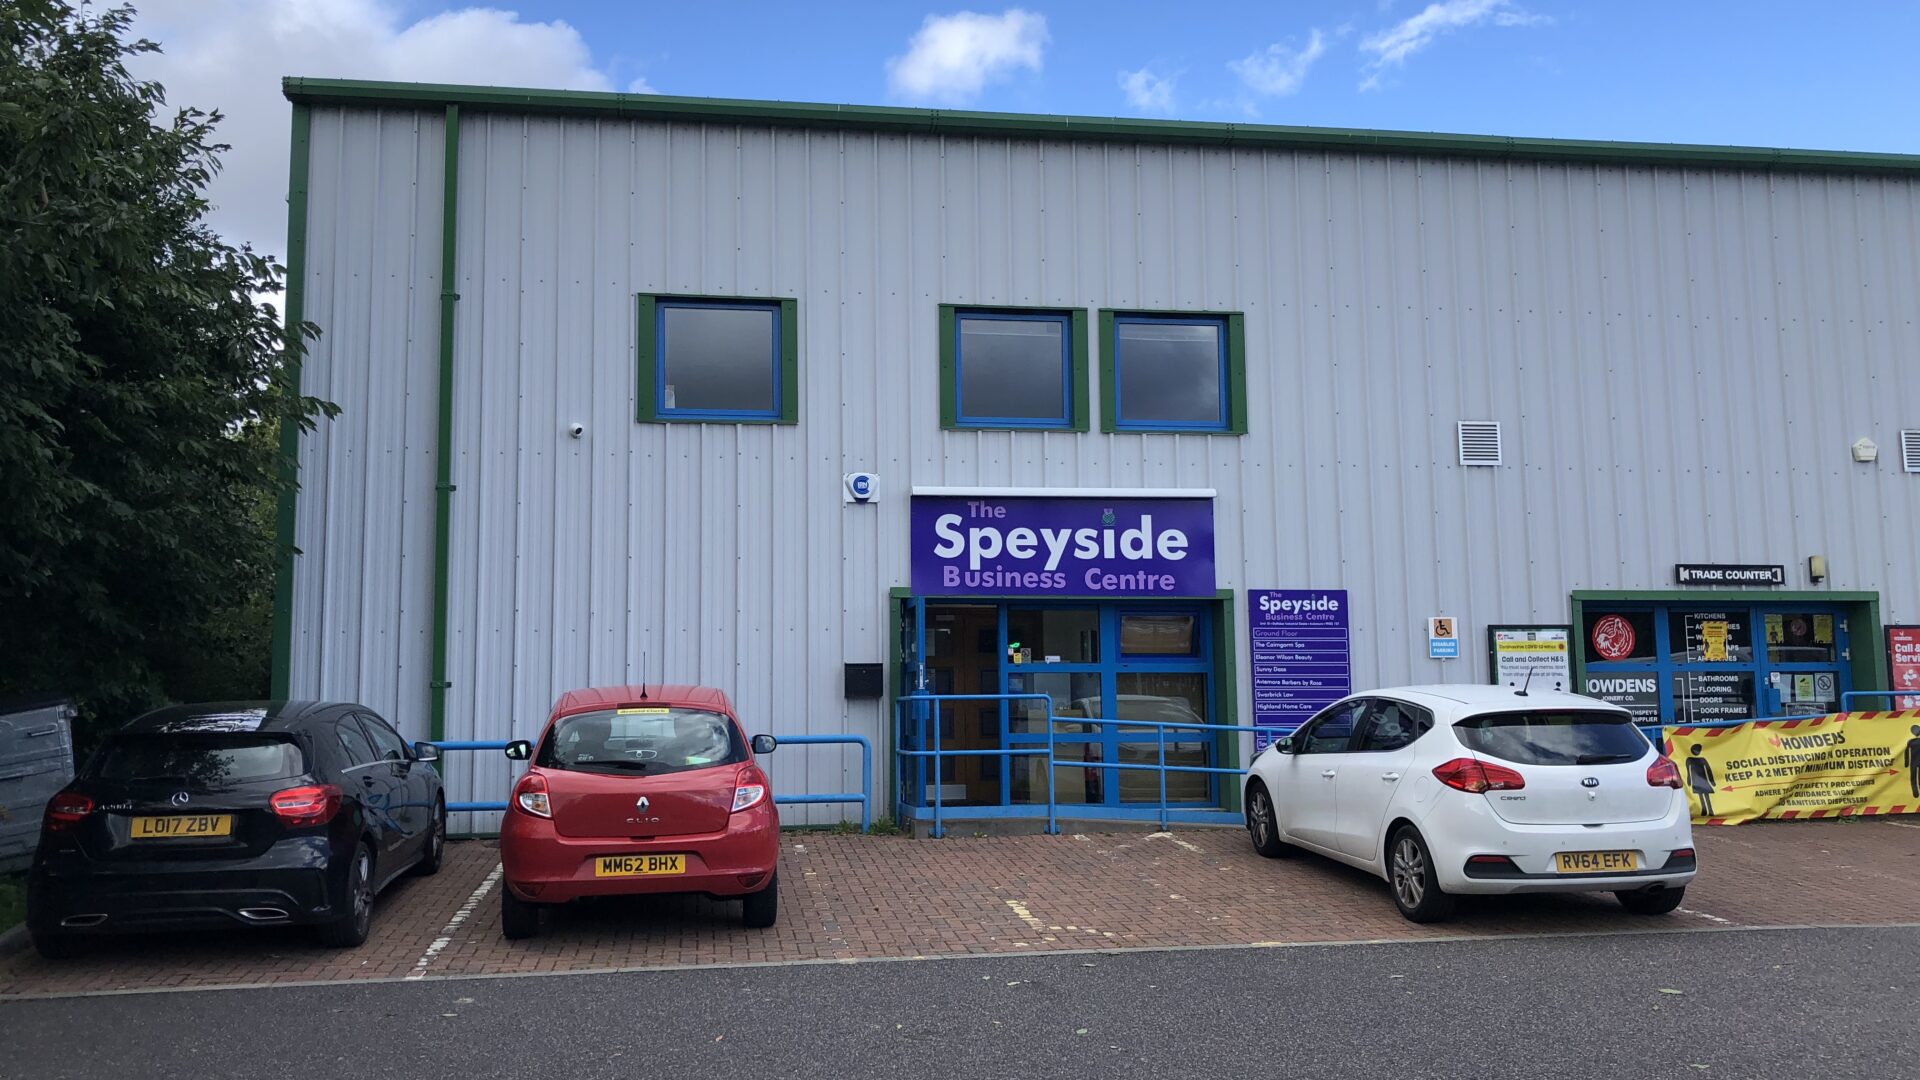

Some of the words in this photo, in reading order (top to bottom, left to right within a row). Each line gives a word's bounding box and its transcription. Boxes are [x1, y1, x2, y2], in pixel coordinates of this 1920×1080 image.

[968, 501, 1006, 518] The
[933, 514, 1189, 571] Speyside
[943, 565, 1067, 589] Business
[1084, 567, 1176, 591] Centre
[1691, 570, 1723, 579] TRADE
[1725, 571, 1772, 580] COUNTER
[1259, 595, 1339, 614] Speyside
[1306, 612, 1335, 620] Centre
[1895, 644, 1913, 653] Call
[1257, 703, 1281, 711] Highland
[1700, 706, 1720, 714] DOOR
[1720, 706, 1748, 714] FRAMES
[1780, 731, 1846, 750] HOWDENS
[1726, 756, 1767, 771] SOCIAL
[1768, 750, 1828, 766] DISTANCING
[1836, 747, 1892, 758] OPERATION
[1724, 770, 1753, 783] KEEP
[1756, 770, 1764, 779] A
[1765, 768, 1773, 778] 2
[1804, 758, 1846, 773] MINIMUM
[1754, 788, 1782, 798] ADHERE
[1786, 798, 1828, 807] SANITISER
[142, 818, 181, 834] LO17
[185, 816, 220, 832] ZBV
[602, 858, 644, 873] MM62
[648, 856, 679, 871] BHX
[1562, 854, 1600, 869] RV64
[1602, 853, 1632, 867] EFK
